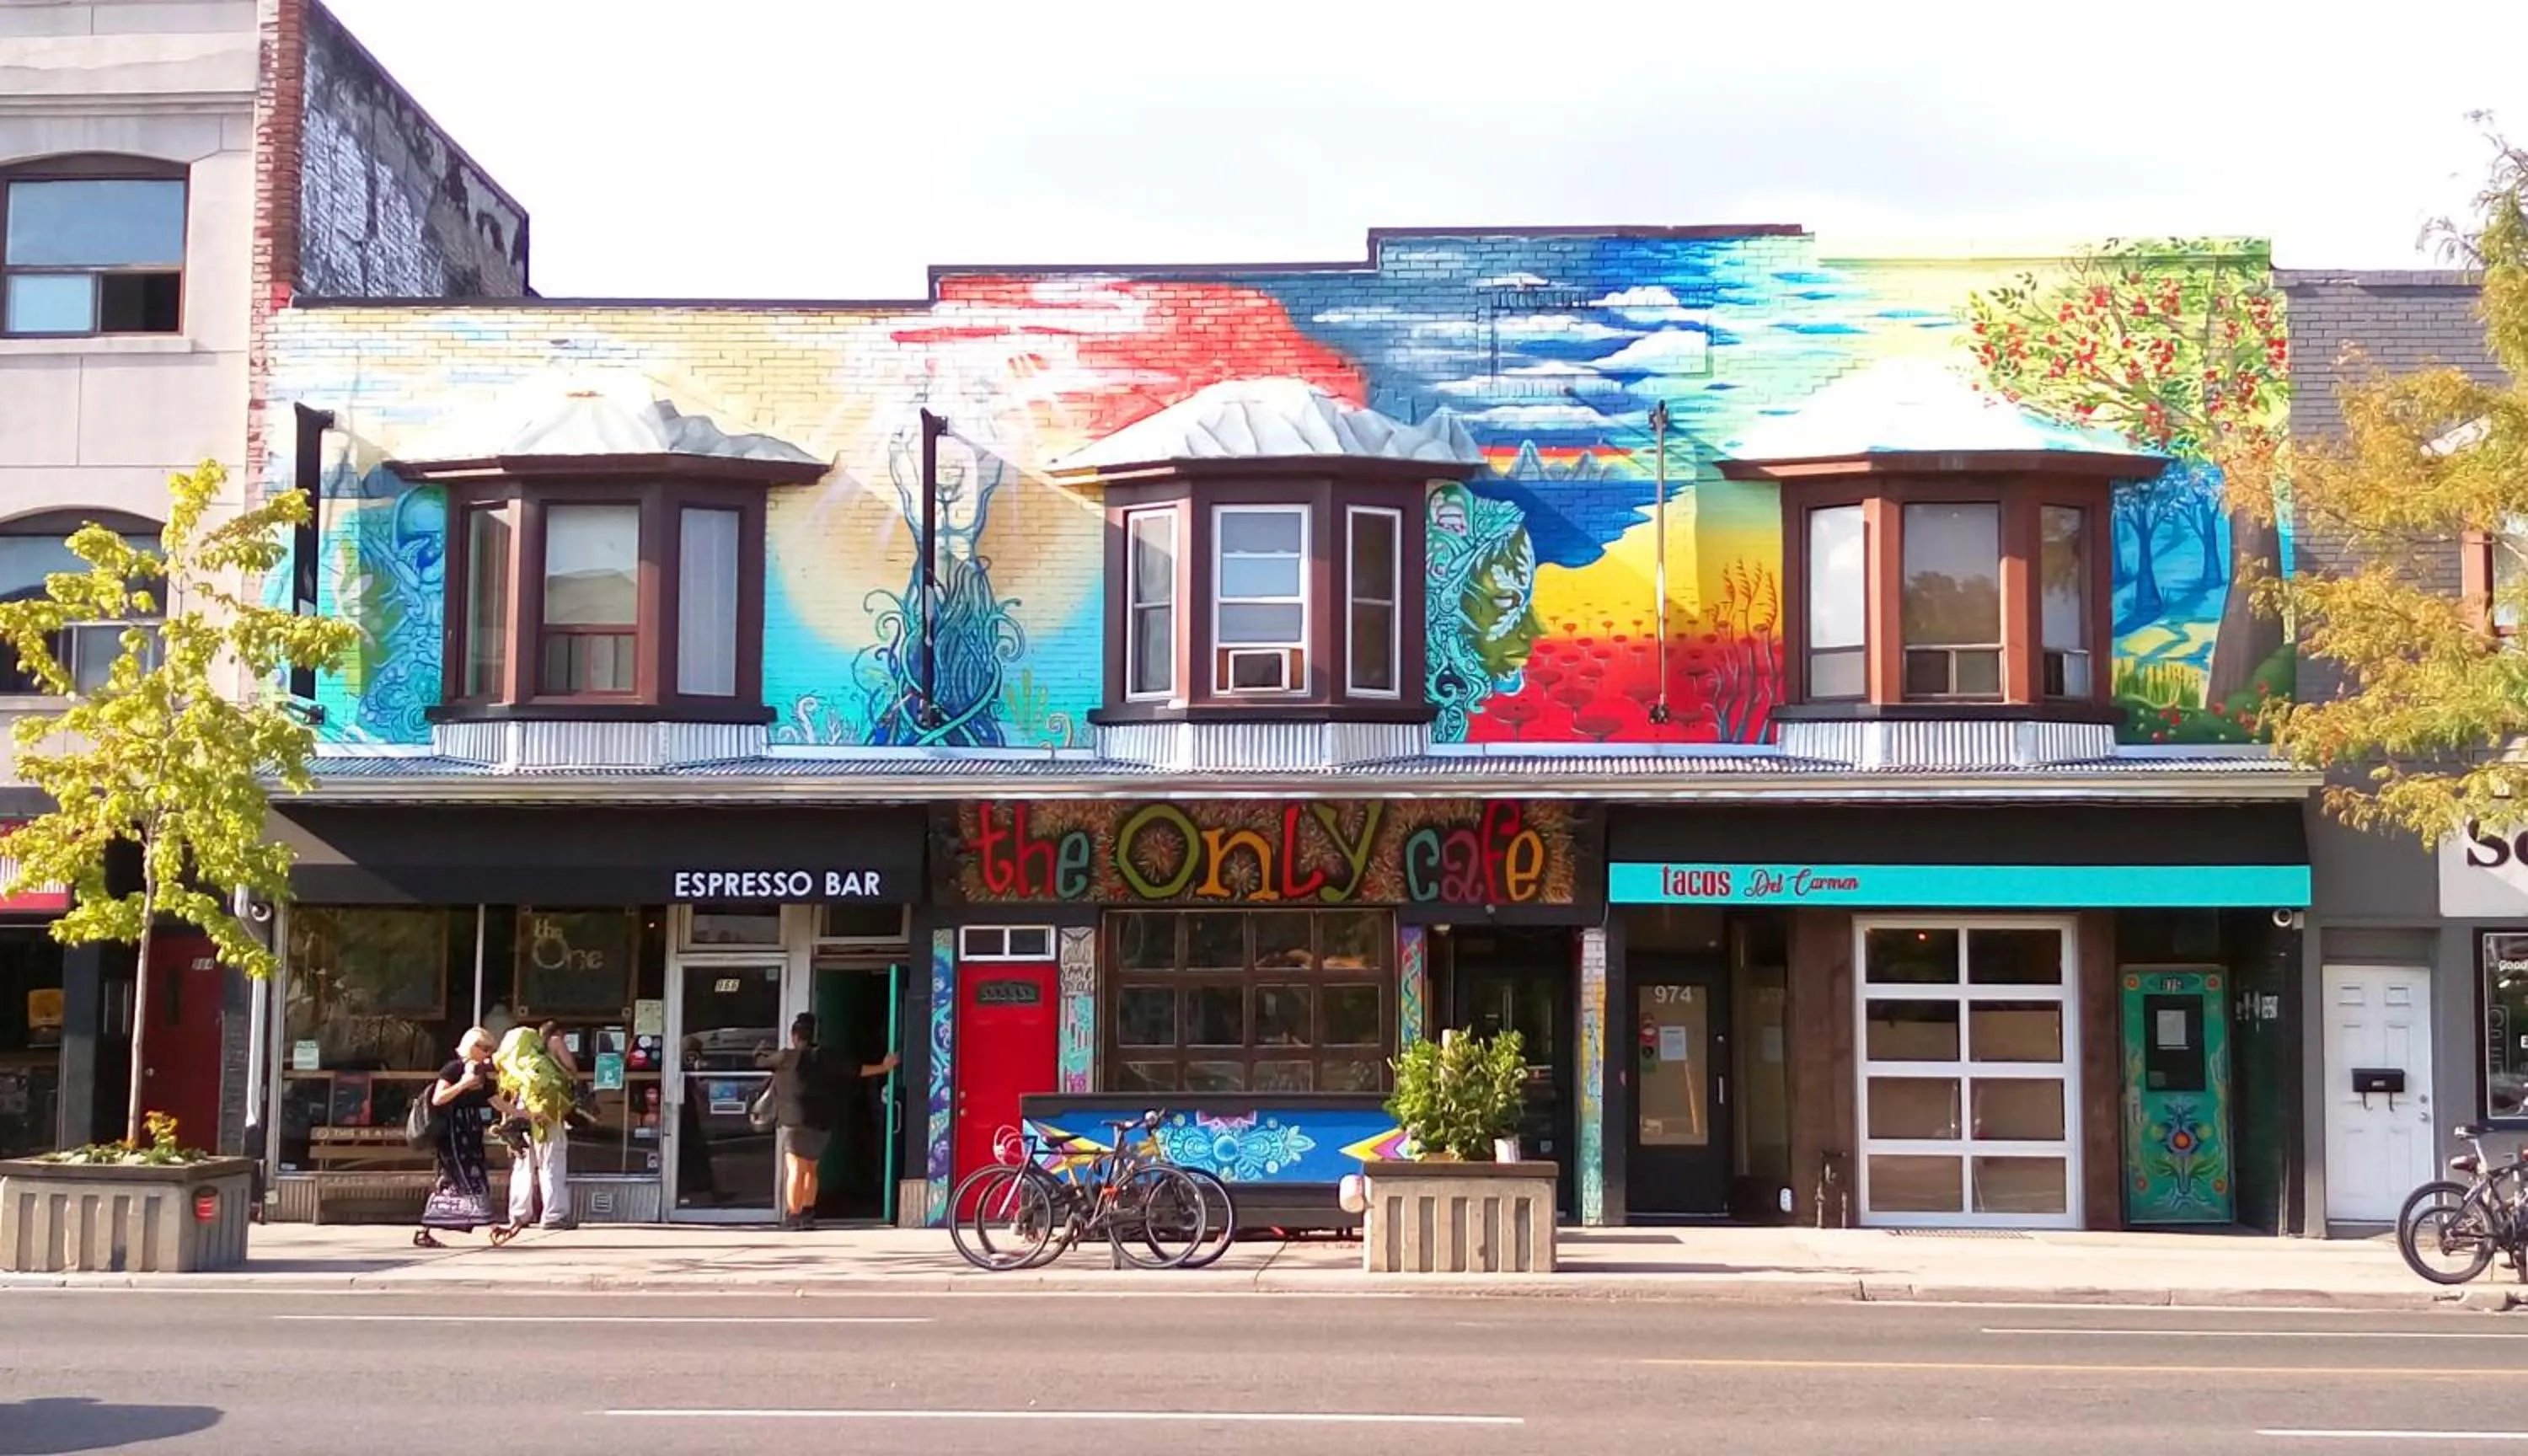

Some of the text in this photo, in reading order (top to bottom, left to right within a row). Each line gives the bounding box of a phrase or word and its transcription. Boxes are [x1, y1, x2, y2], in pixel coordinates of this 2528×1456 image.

[969, 801, 1090, 898] the
[1406, 800, 1544, 903] cafe
[675, 871, 880, 897] ESPRESSO BAR
[1663, 864, 1859, 897] tacos Del Carmen
[533, 918, 564, 939] the
[532, 936, 604, 972] One
[1654, 985, 1693, 1004] 974
